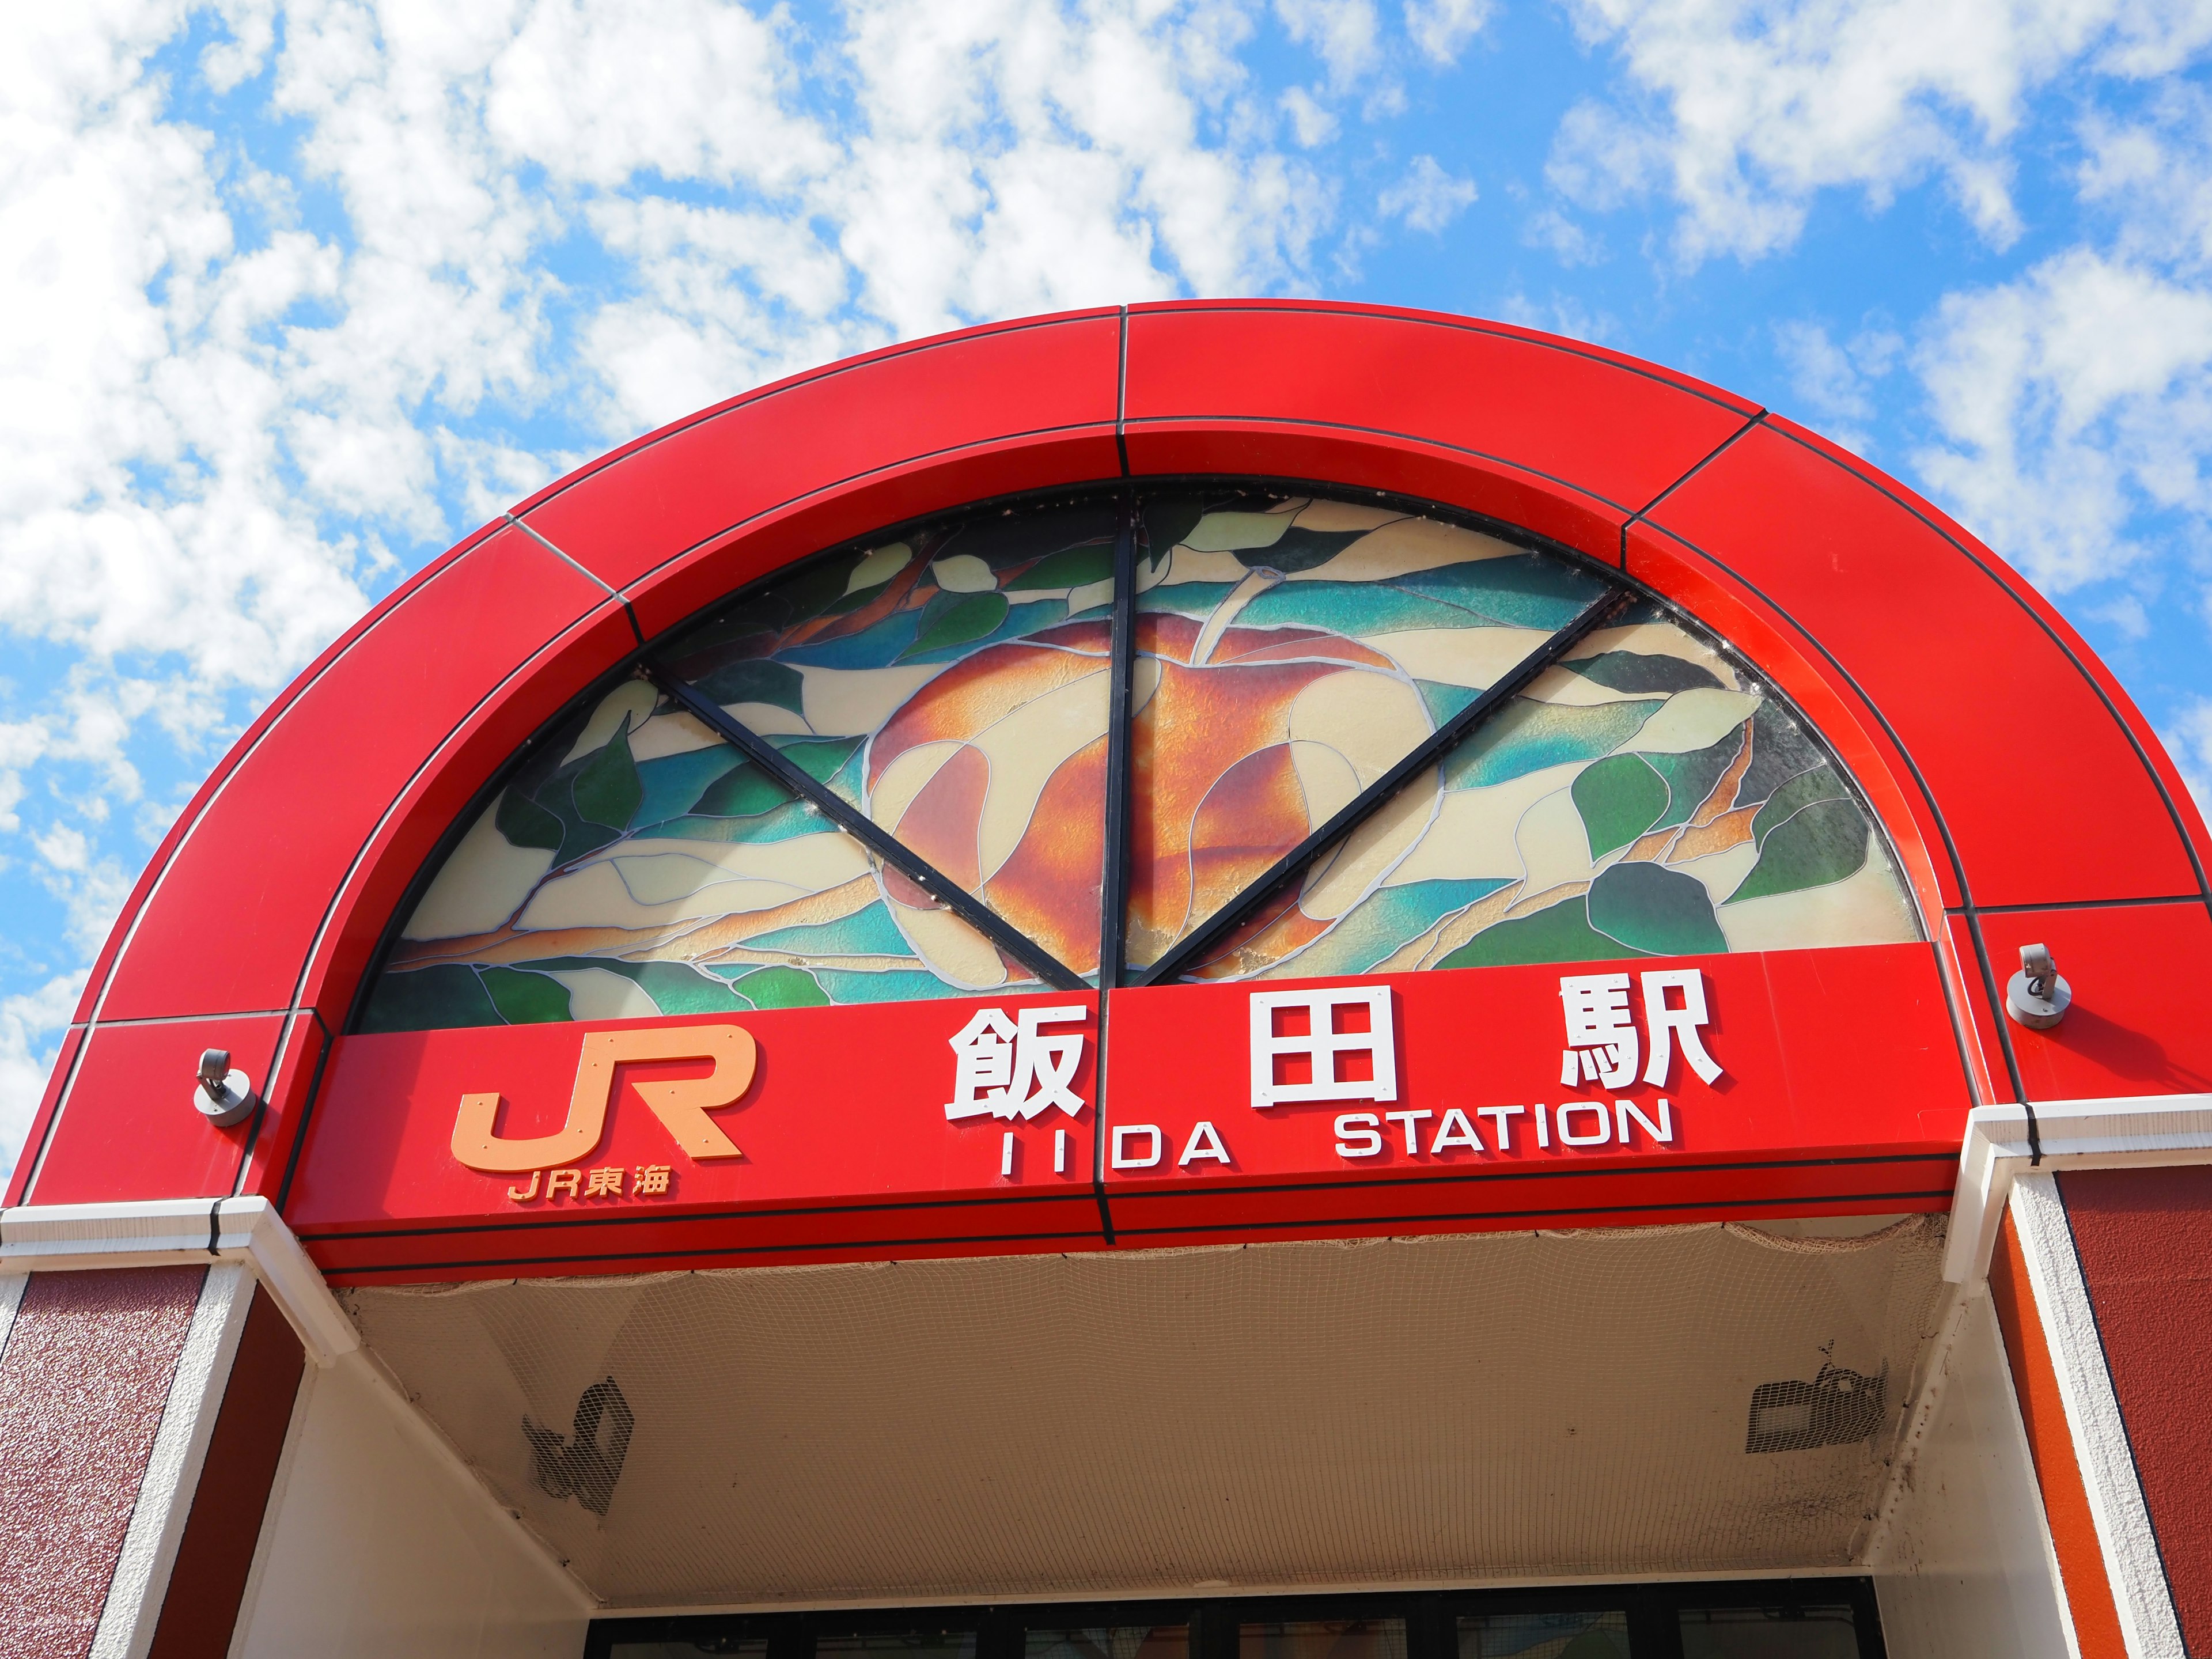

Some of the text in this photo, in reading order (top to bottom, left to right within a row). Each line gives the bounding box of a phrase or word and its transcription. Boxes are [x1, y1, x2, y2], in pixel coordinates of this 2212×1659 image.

[451, 1024, 756, 1173] JR
[944, 968, 1724, 1121] 飯田駅
[507, 1164, 672, 1202] JR東海
[1001, 1098, 1673, 1176] IIDA STATION
